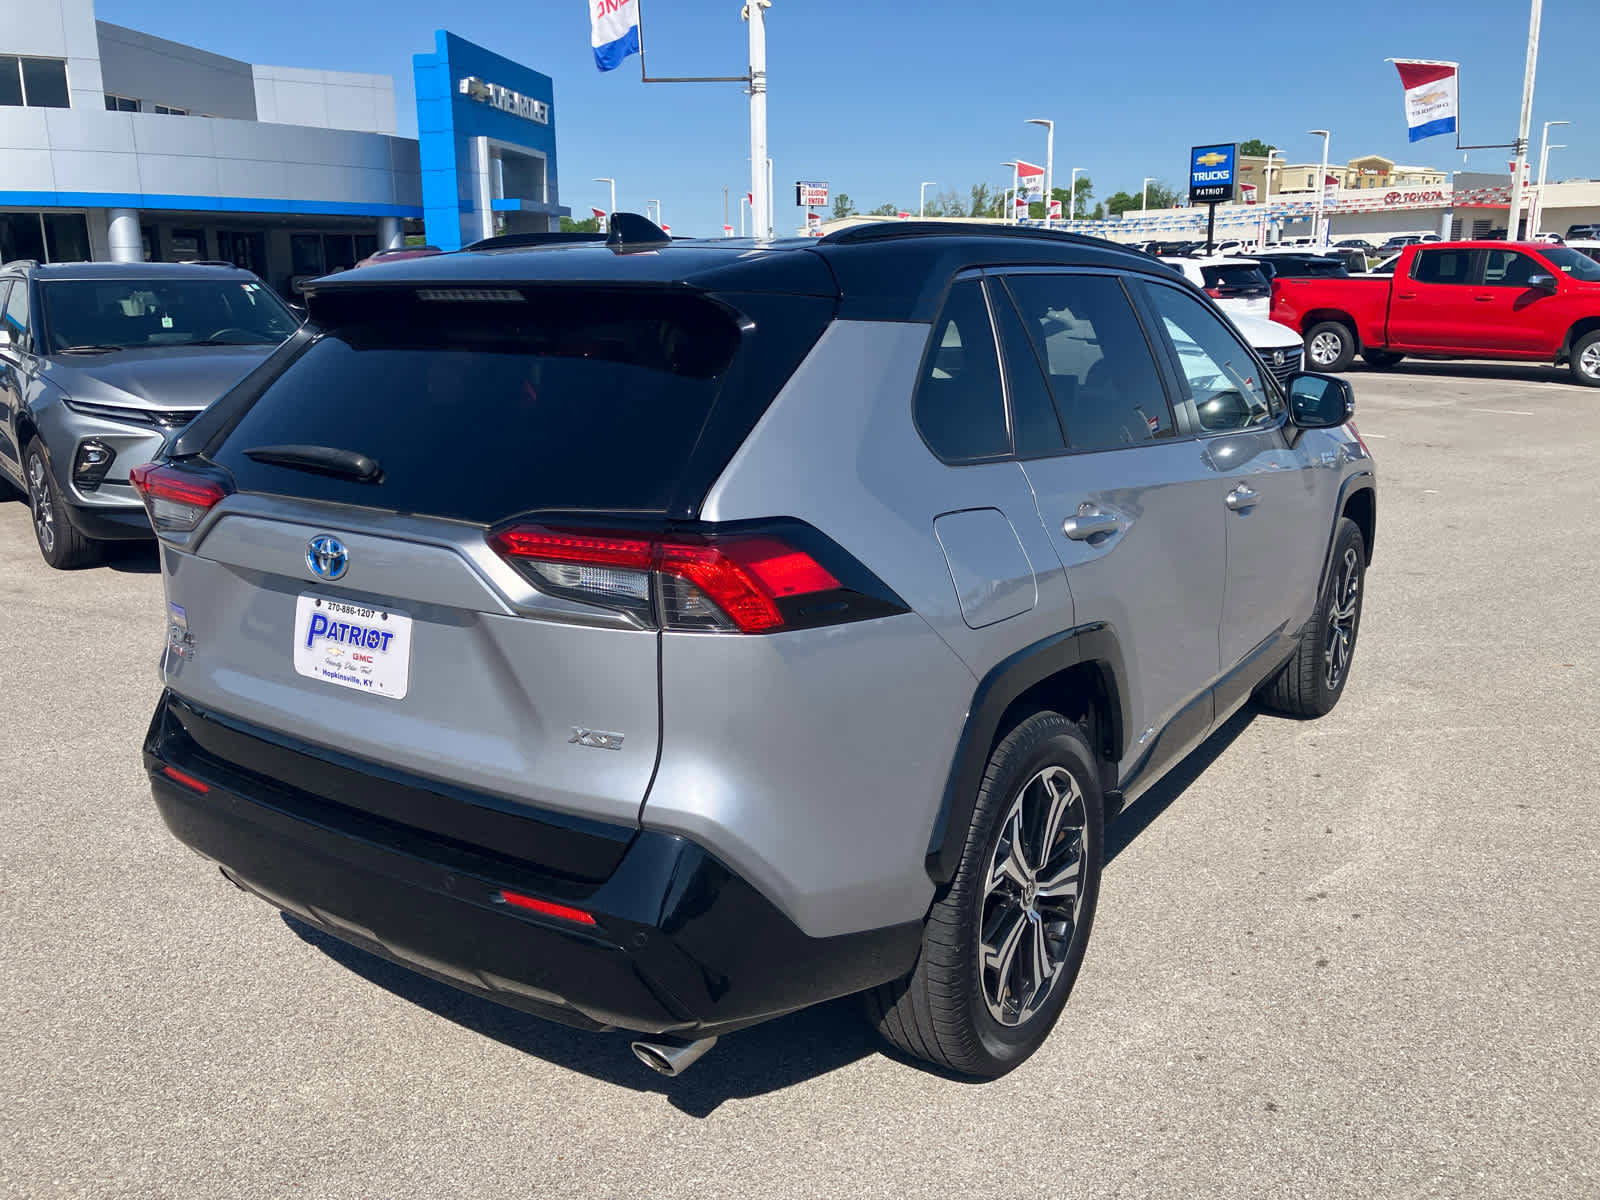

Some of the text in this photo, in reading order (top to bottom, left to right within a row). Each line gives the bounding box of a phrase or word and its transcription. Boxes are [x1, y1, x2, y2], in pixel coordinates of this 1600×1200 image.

[486, 83, 549, 125] CHEVROLET
[1193, 170, 1229, 181] TRUCKS
[1196, 188, 1224, 196] PATRIOT
[1402, 191, 1444, 203] TOYOTA
[327, 602, 375, 619] 270-886-1207
[307, 612, 394, 651] PATRIOT
[352, 652, 374, 664] GMC
[322, 668, 374, 687] Hopkinsville, KY
[568, 726, 624, 750] XSE
